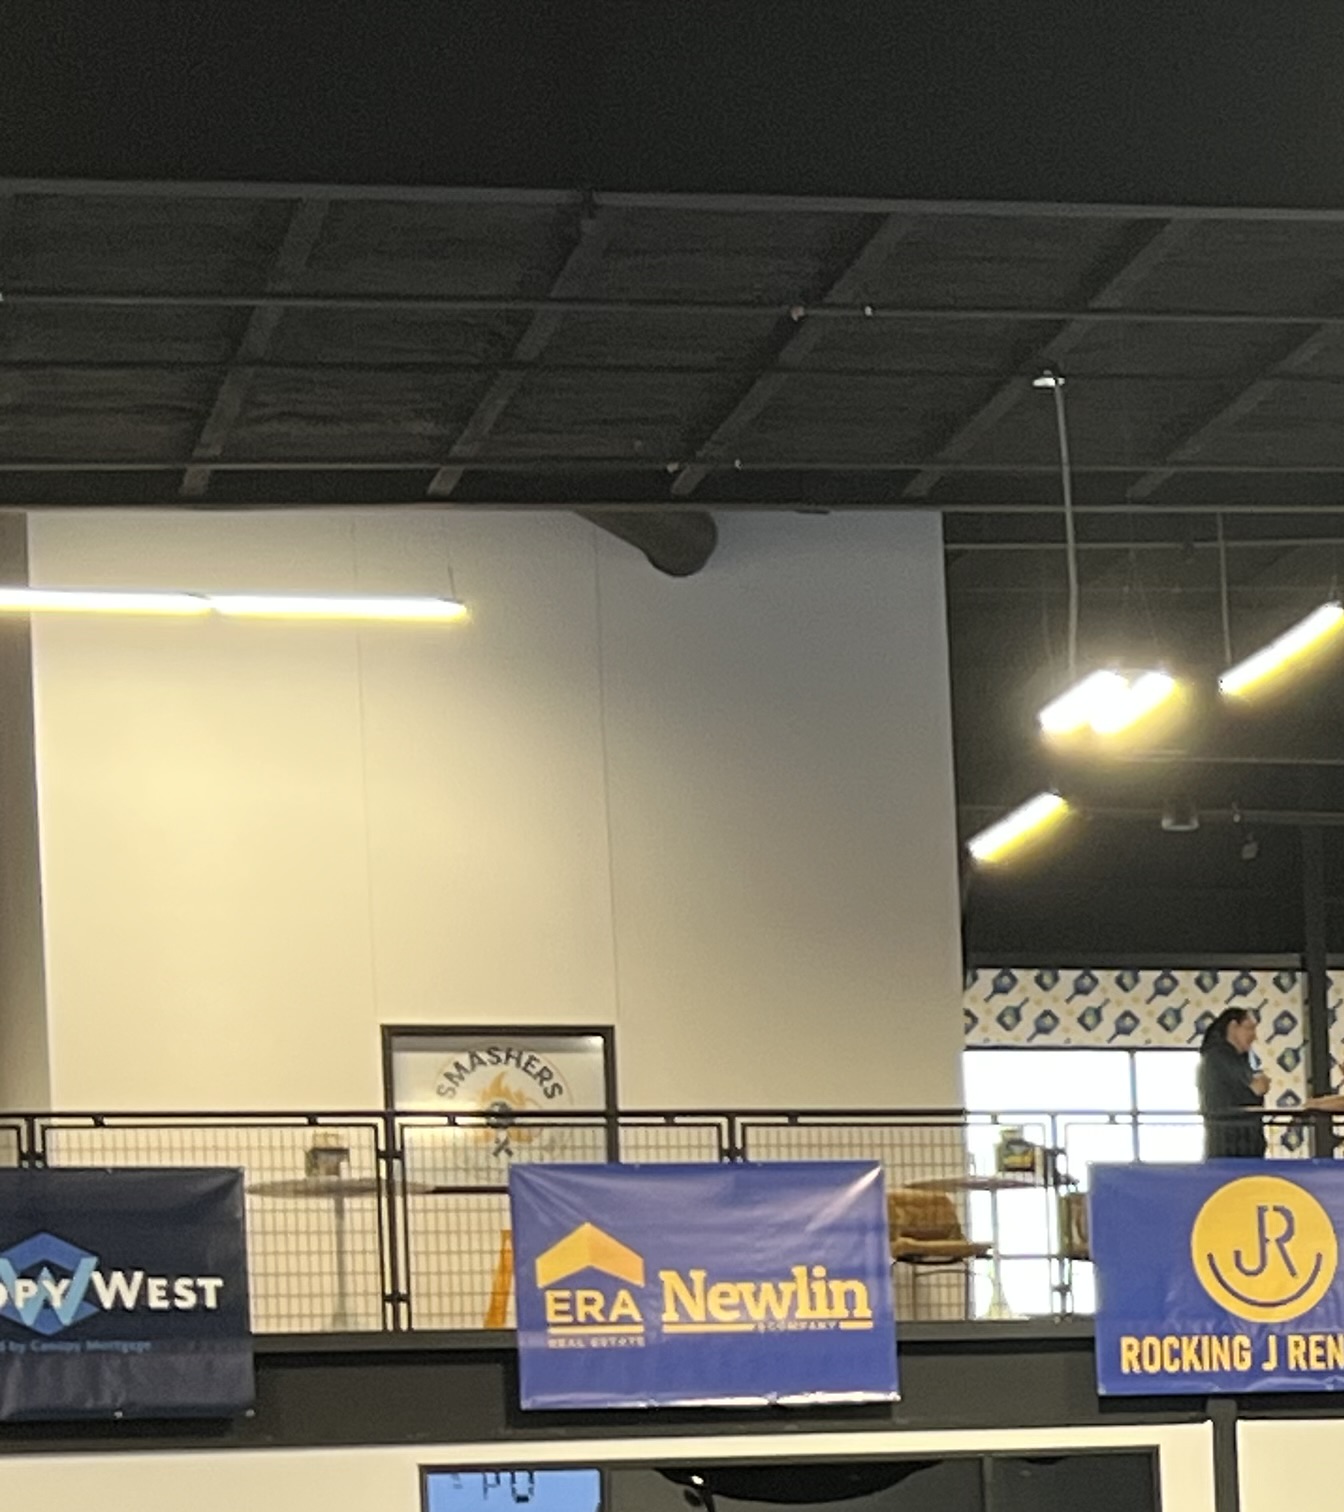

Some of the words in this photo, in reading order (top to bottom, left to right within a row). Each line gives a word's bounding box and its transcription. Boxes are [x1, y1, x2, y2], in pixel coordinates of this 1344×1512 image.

[436, 1046, 563, 1100] SMASHERS
[545, 1289, 642, 1323] ERA
[659, 1265, 873, 1322] Newlin
[547, 1337, 585, 1348] REAL
[590, 1336, 645, 1347] ESTATE
[1120, 1335, 1252, 1374] ROCKING
[1262, 1335, 1278, 1371] J
